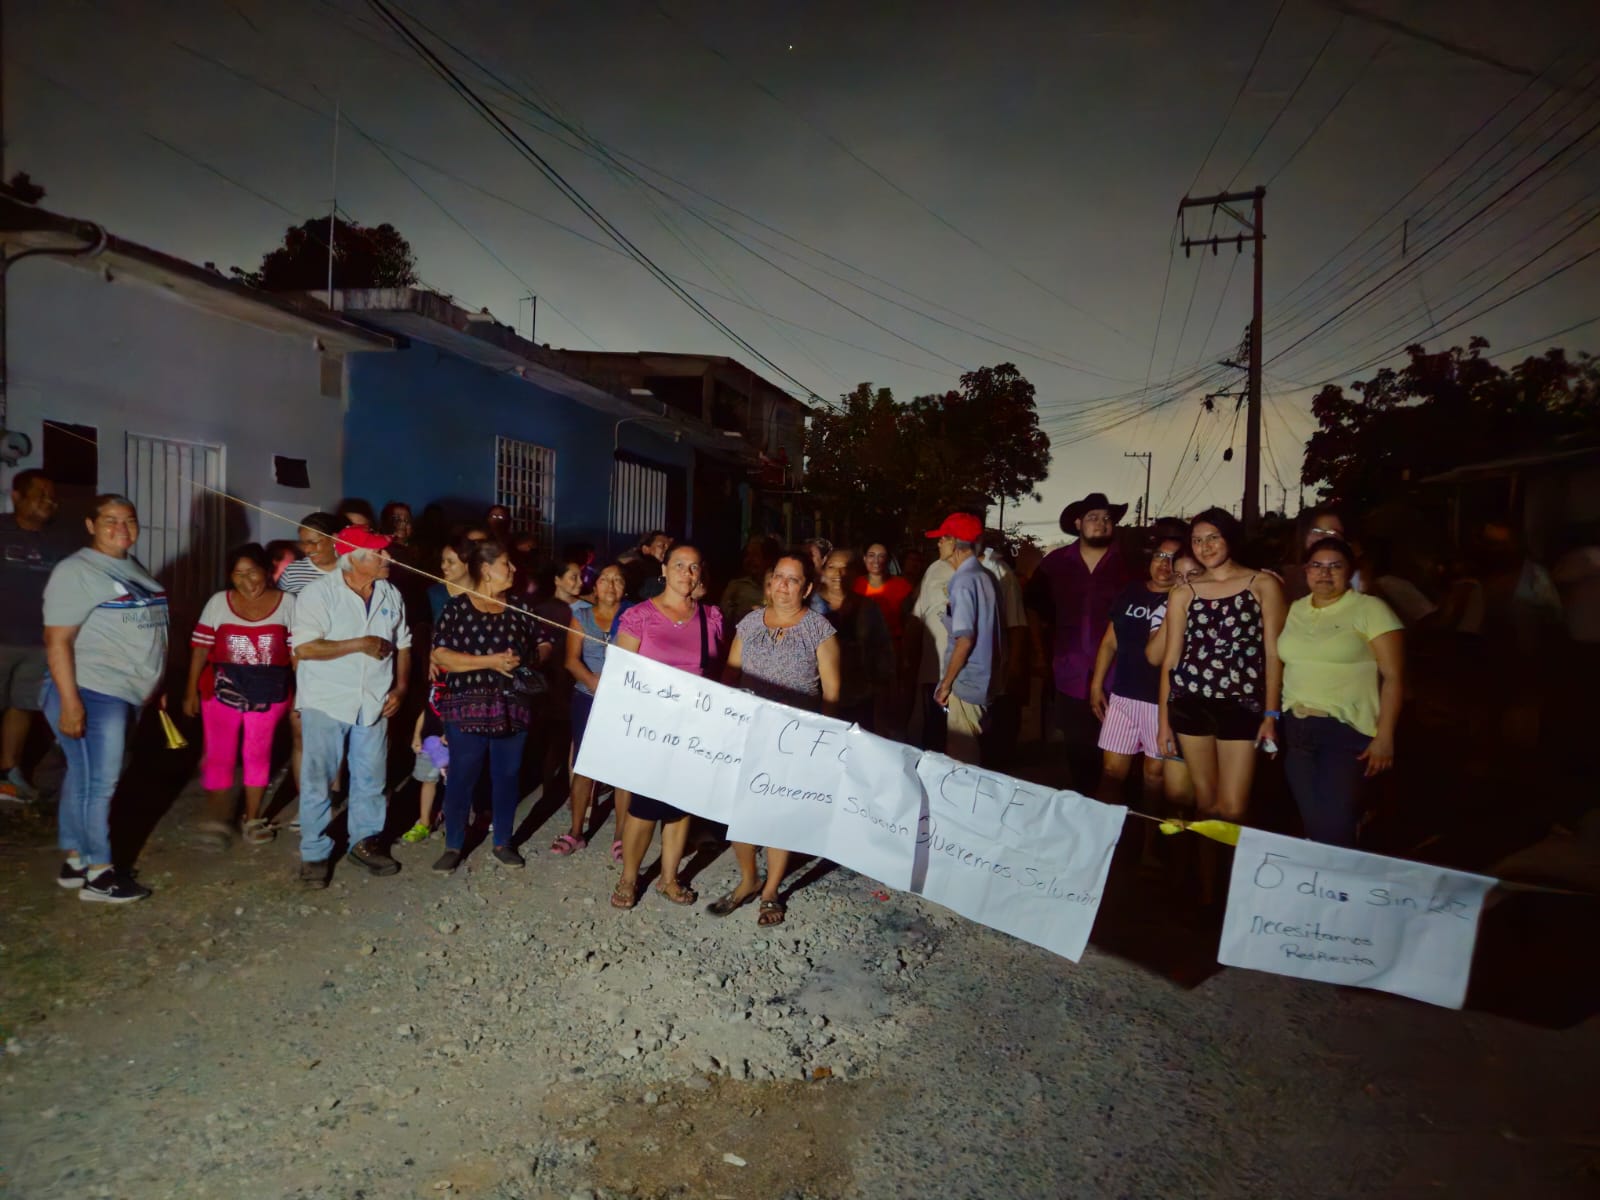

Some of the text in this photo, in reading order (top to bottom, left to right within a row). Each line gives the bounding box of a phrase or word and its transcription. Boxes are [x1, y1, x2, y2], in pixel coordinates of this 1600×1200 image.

[1124, 602, 1158, 621] LOV
[623, 671, 651, 694] Mas
[749, 772, 834, 805] Queremos
[940, 765, 1036, 837] CFE
[916, 815, 1012, 879] Queremos
